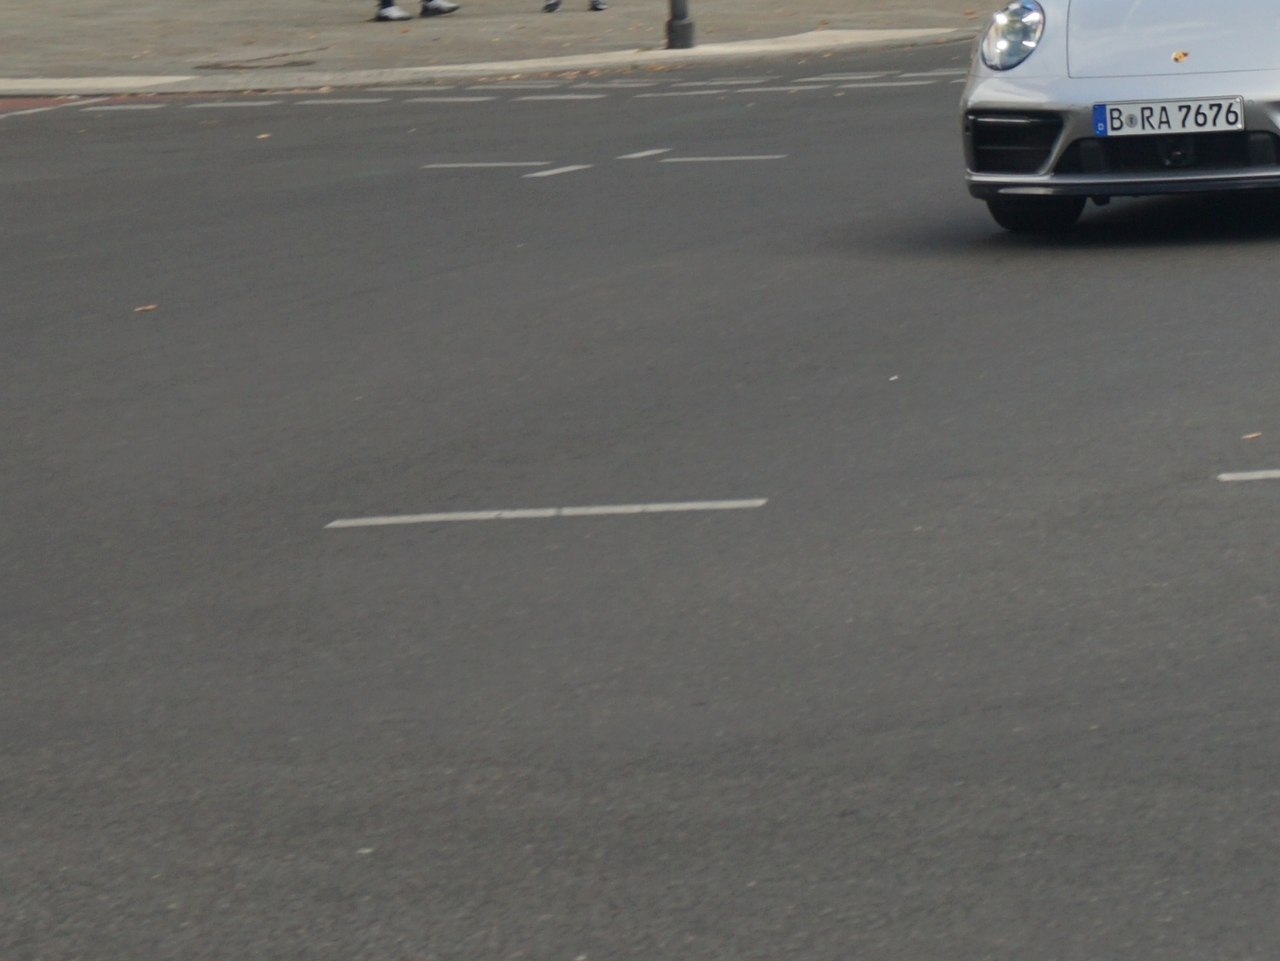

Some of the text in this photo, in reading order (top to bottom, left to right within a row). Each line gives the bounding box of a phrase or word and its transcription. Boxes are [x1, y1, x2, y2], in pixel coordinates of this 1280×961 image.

[1109, 102, 1239, 131] B RA 7676
